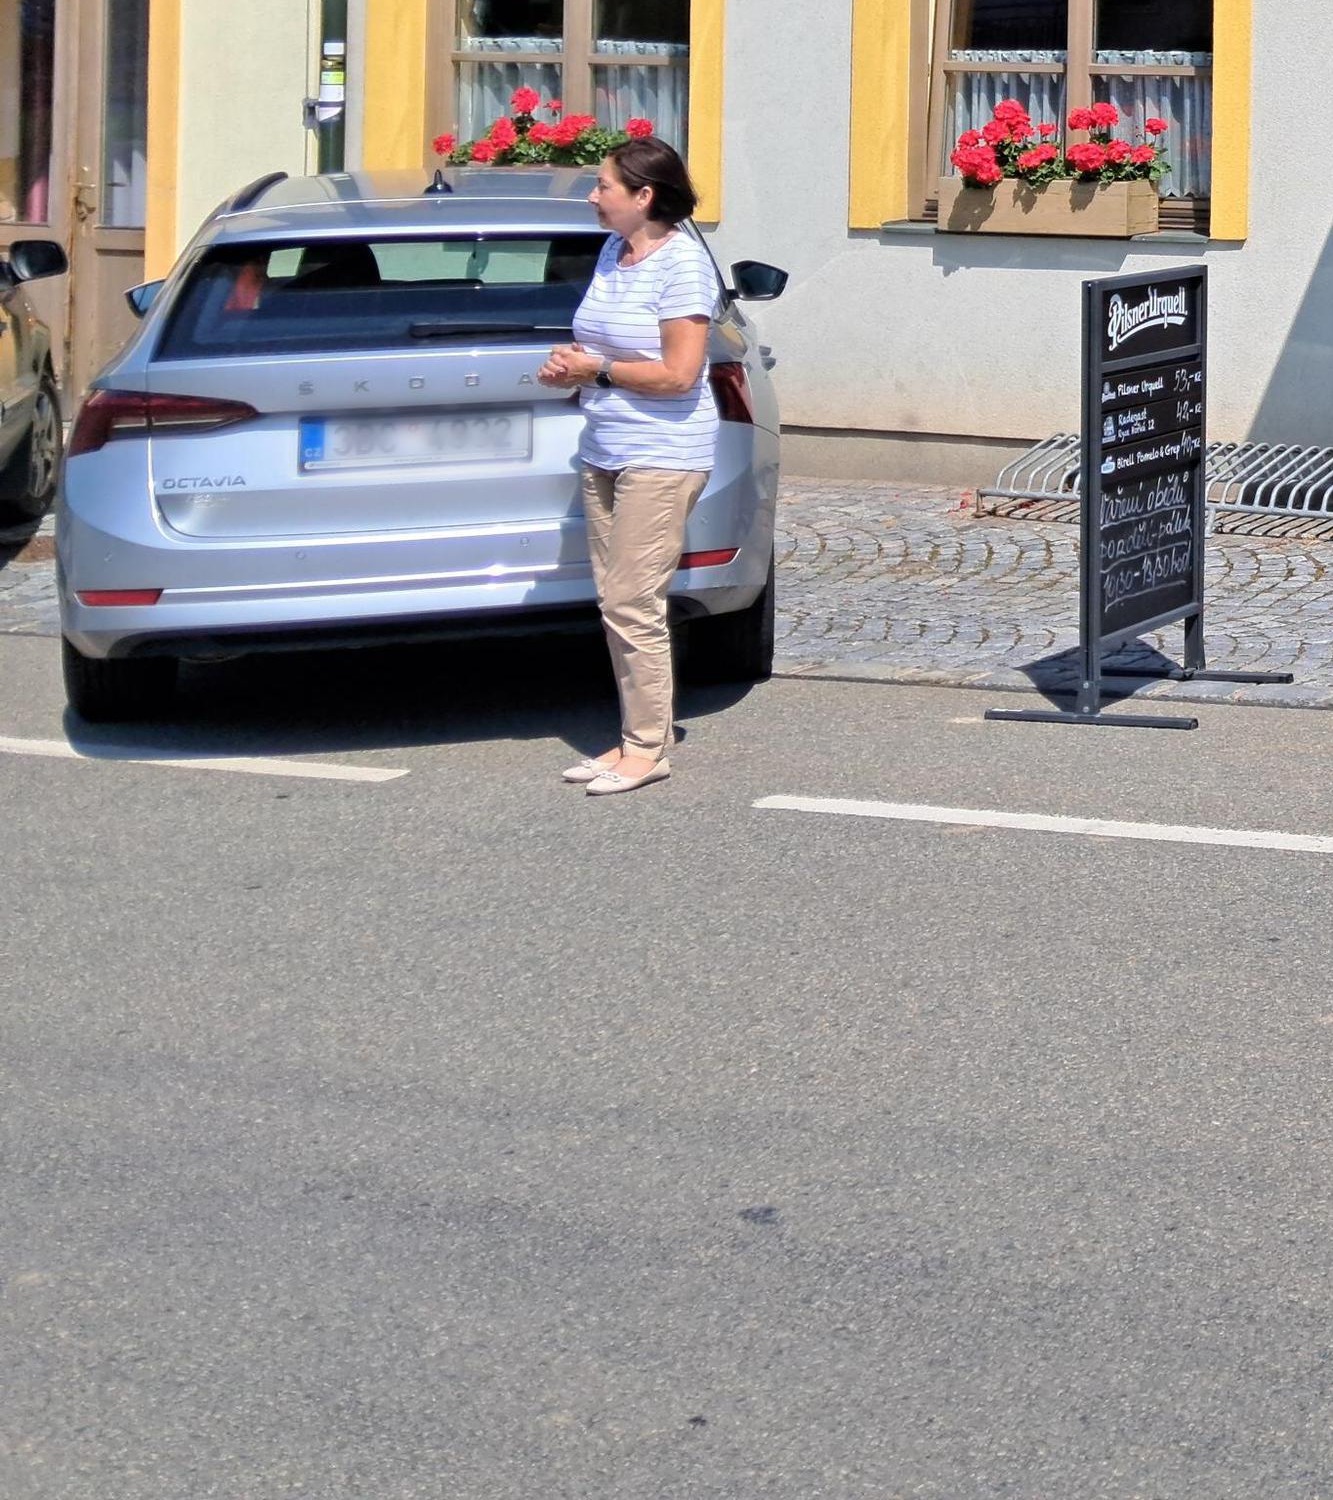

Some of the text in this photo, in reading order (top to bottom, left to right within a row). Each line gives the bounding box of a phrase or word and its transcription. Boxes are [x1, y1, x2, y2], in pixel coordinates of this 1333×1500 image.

[1108, 293, 1150, 352] Pilsner
[299, 372, 535, 396] ŠKODA
[1117, 384, 1140, 397] Pilsner
[1141, 376, 1164, 397] Urquell
[305, 448, 321, 457] CZ
[1116, 453, 1135, 470] Birell
[1136, 446, 1159, 464] Pomelo
[1164, 444, 1180, 460] Grep
[162, 476, 246, 490] OCTAVIA
